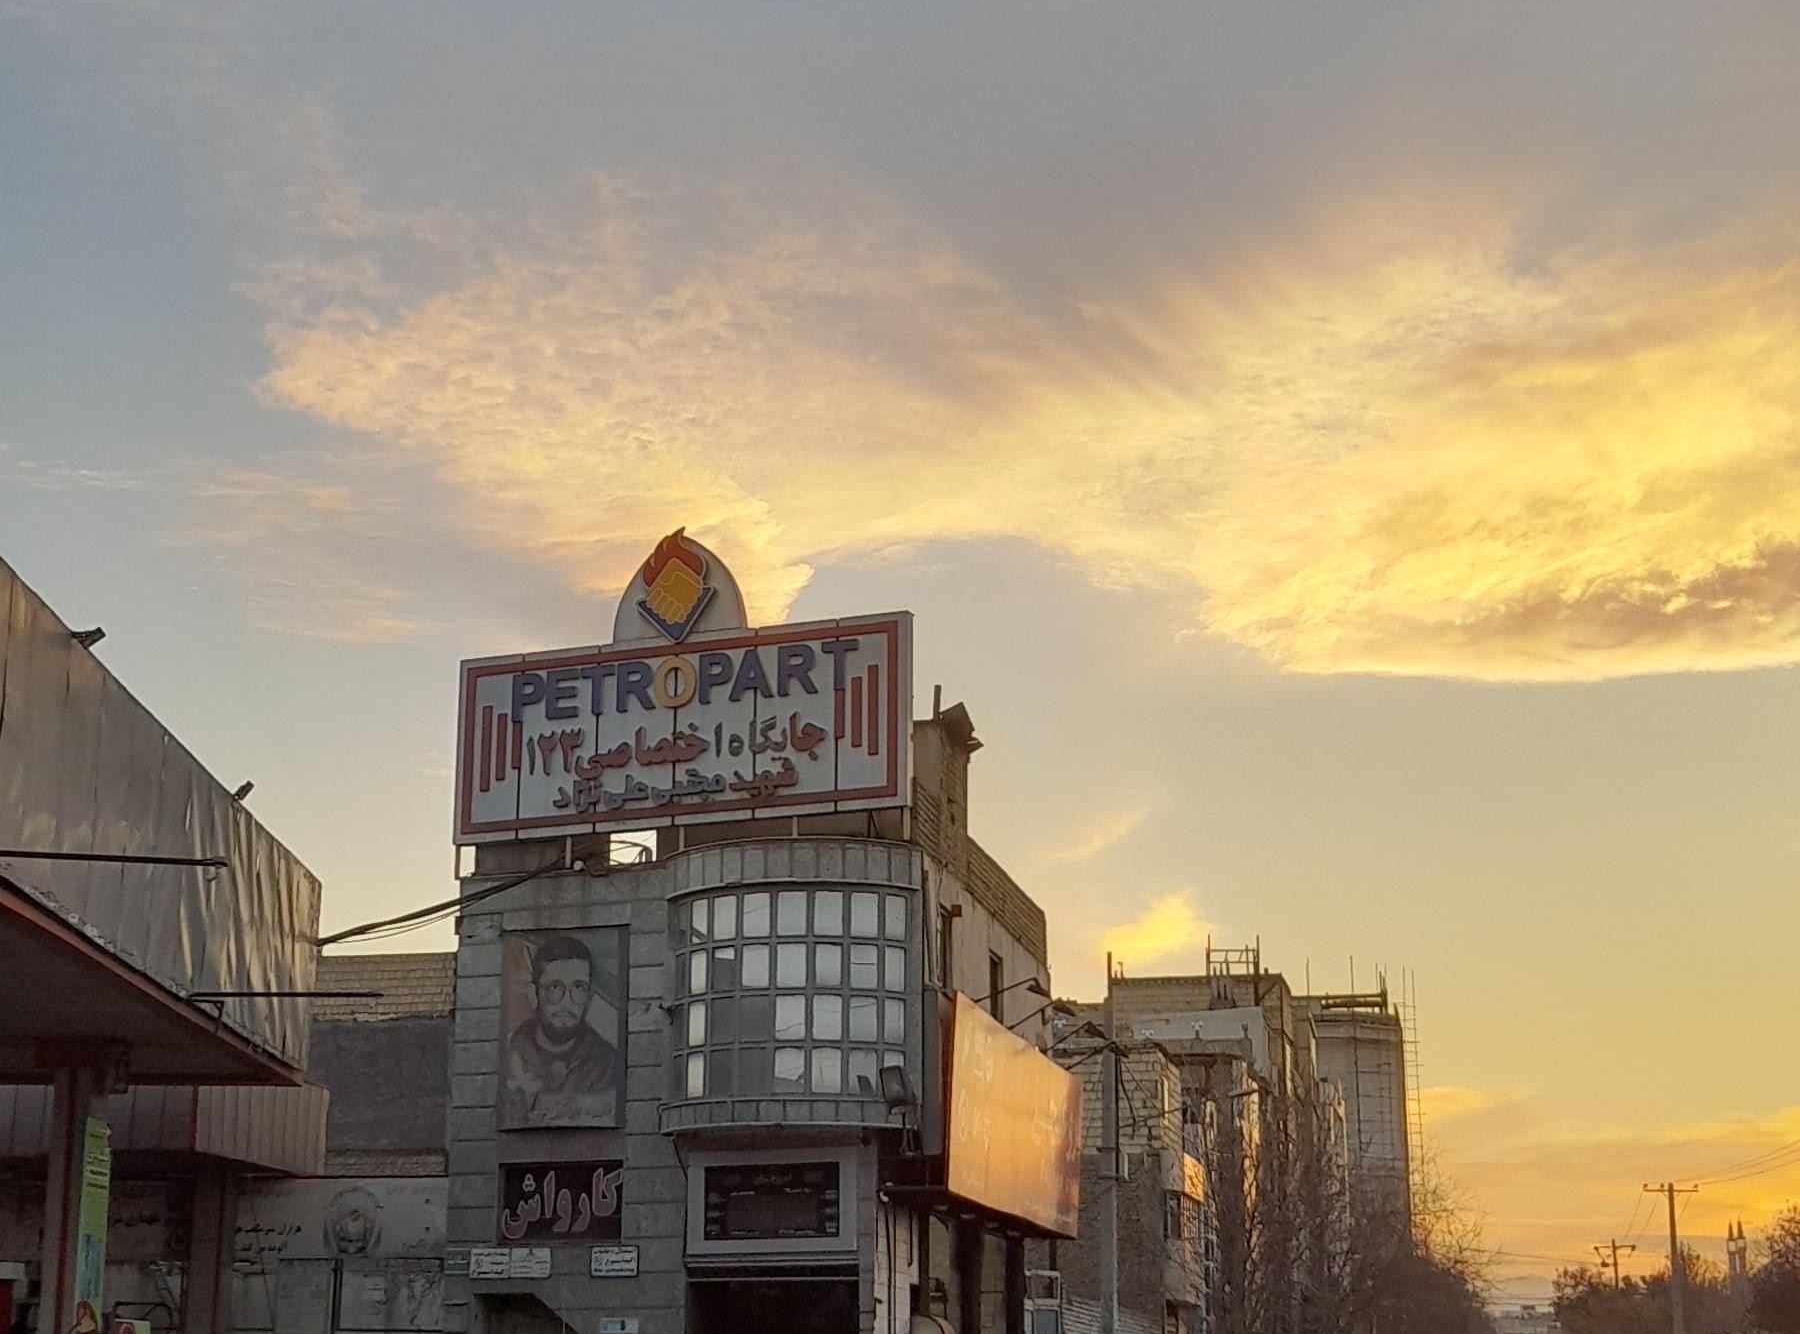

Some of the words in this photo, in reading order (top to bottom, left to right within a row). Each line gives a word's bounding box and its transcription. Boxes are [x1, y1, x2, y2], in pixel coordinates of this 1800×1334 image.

[511, 639, 859, 722] PETROPART
[574, 721, 723, 780] اختصاصی
[728, 712, 827, 760] جایگاه
[729, 756, 800, 797] شهید
[502, 1167, 624, 1239] کارواش
